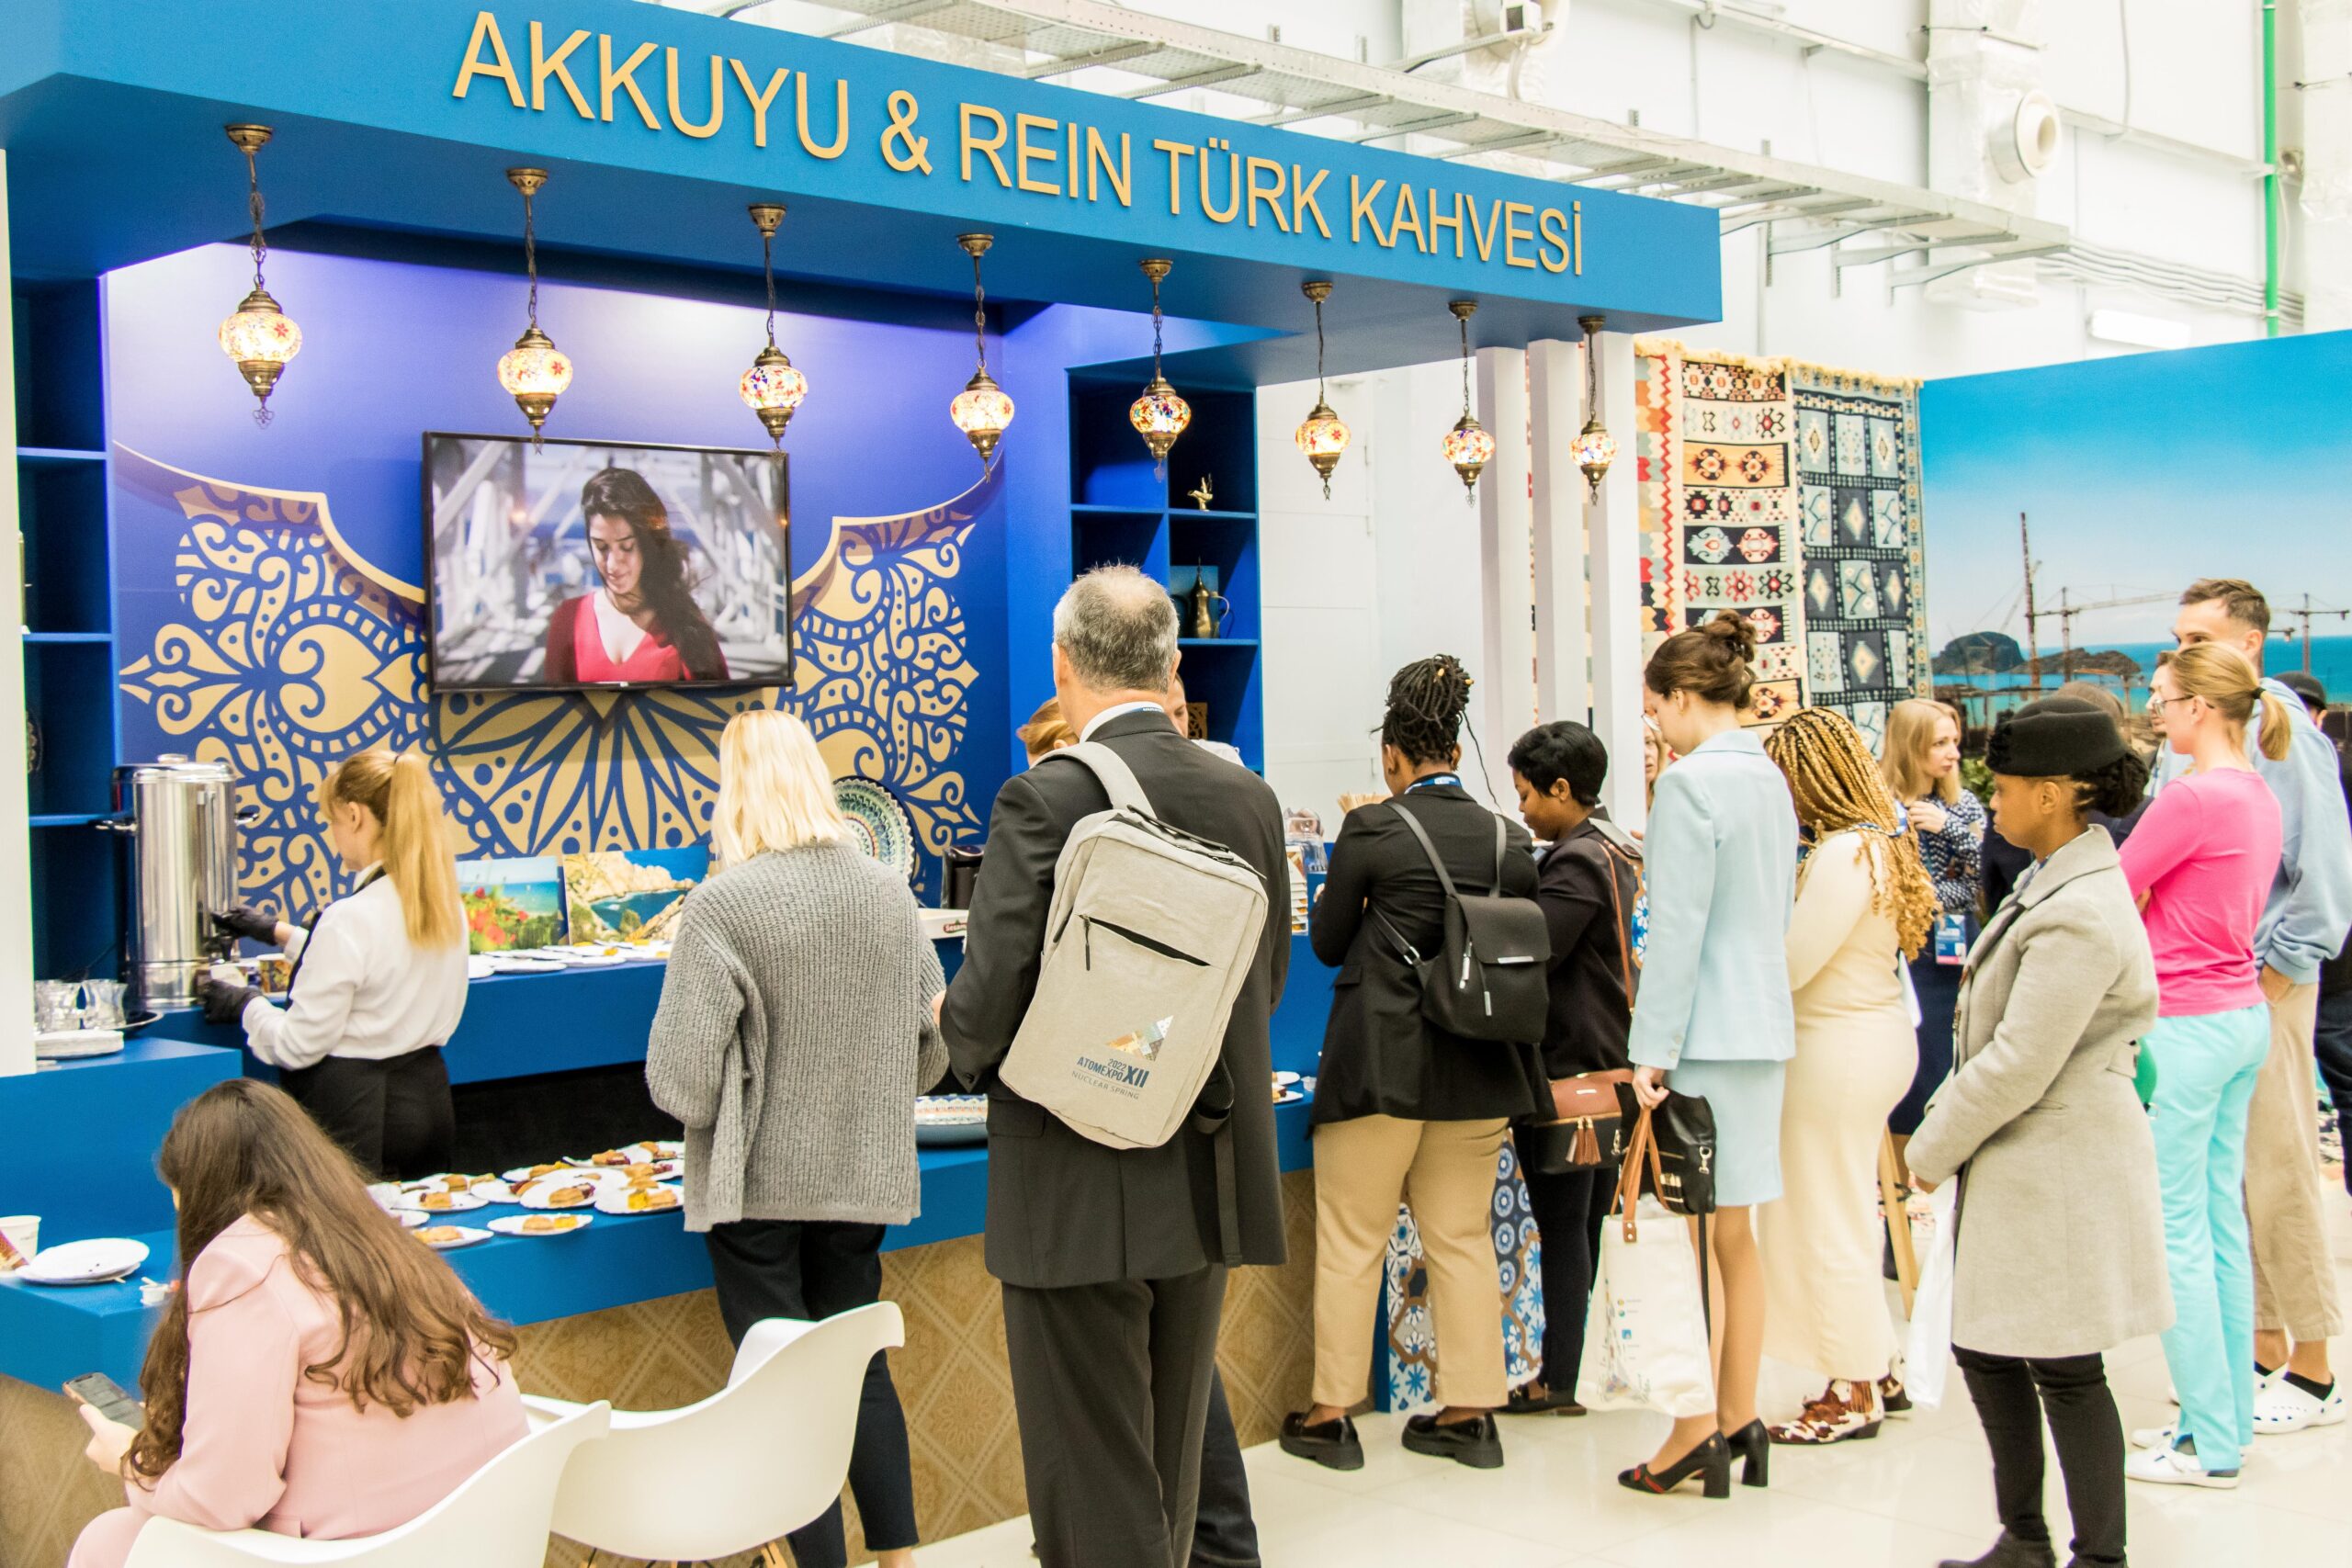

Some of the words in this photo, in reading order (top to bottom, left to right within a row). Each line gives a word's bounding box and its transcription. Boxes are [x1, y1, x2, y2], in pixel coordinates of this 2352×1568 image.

[452, 11, 848, 160] AKKUYU
[880, 89, 933, 175] &
[959, 102, 1132, 208] REIN
[1153, 137, 1331, 239] TÜRK
[1350, 175, 1582, 276] KAHVESİ
[1077, 1056, 1124, 1081] ATOMEXPO
[1122, 1065, 1149, 1088] XII
[1107, 1058, 1127, 1072] 2022
[1071, 1070, 1108, 1090] NUCLEAR
[1111, 1085, 1140, 1100] SPRING
